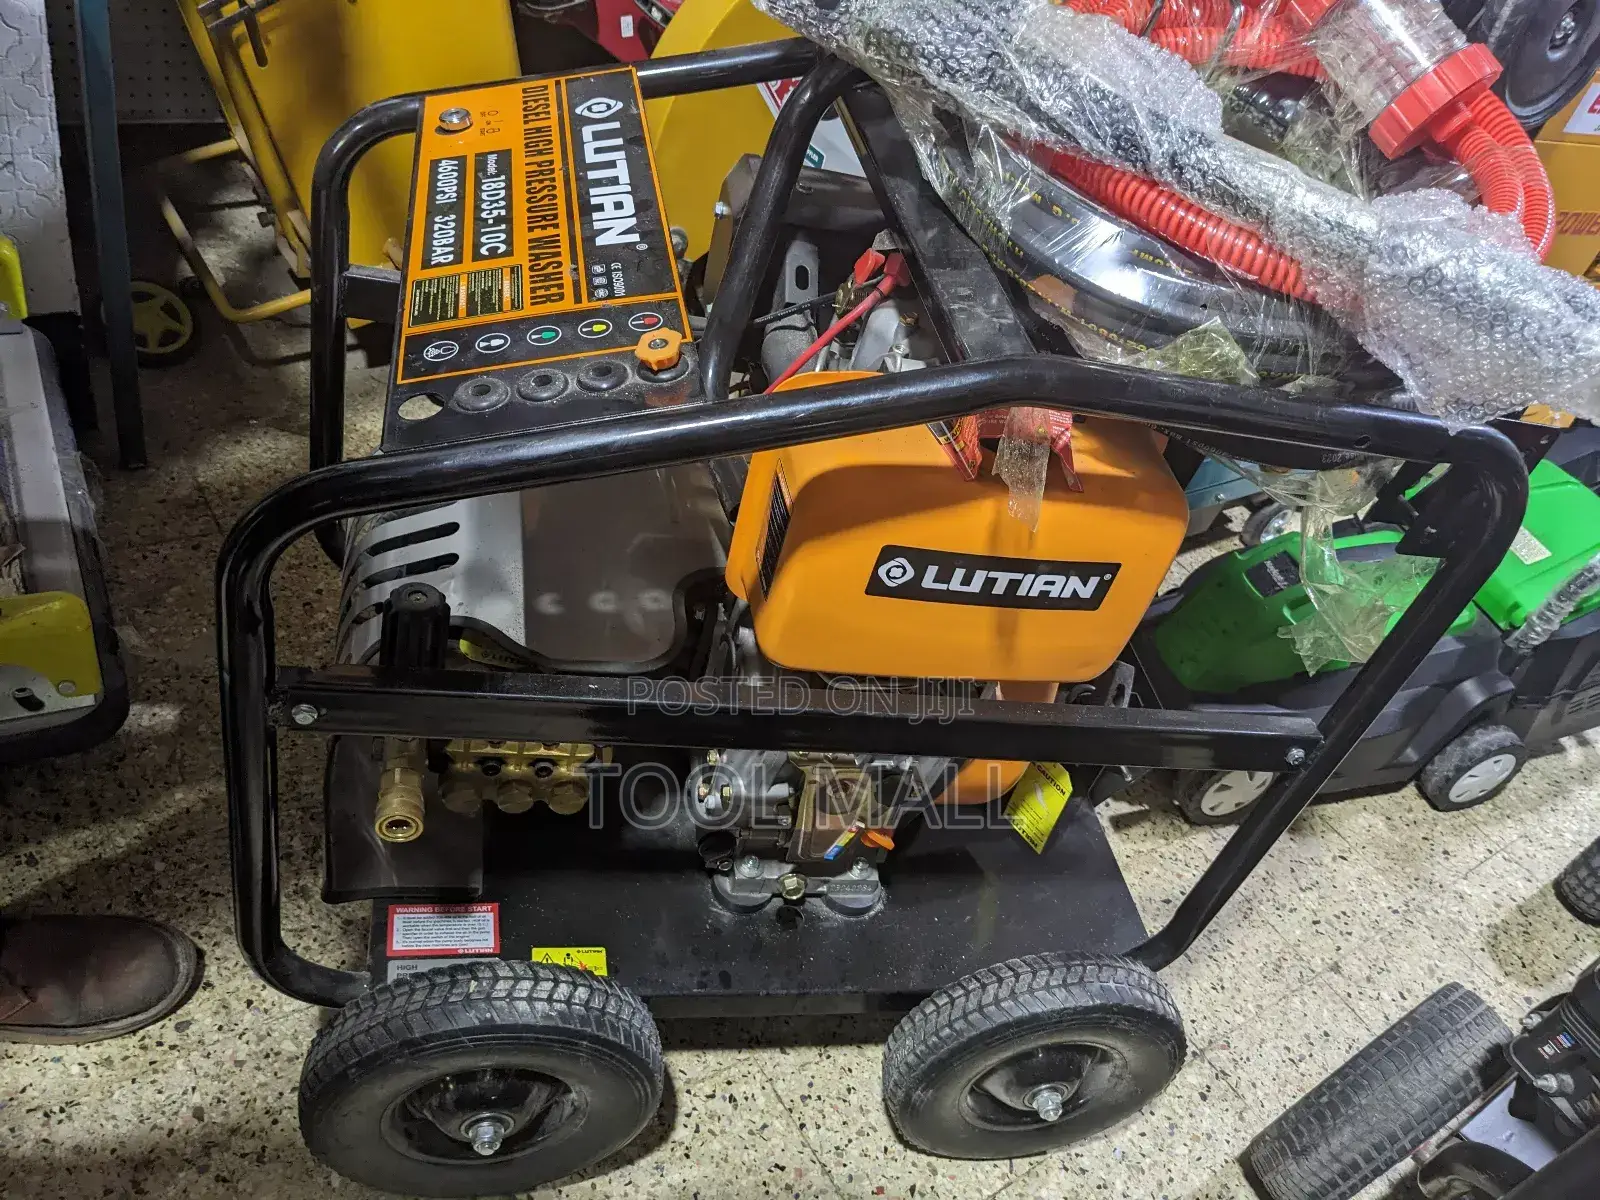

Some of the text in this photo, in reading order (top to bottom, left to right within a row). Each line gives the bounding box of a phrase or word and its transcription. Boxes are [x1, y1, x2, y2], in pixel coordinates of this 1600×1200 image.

[435, 158, 459, 205] 4600PSI
[486, 153, 499, 177] Model:
[582, 121, 640, 247] LUTIAN
[479, 175, 507, 257] 18D35-10C
[522, 85, 565, 306] DIESEL HIGH PRESSURE WASHER
[430, 214, 456, 266] 320BAR
[921, 564, 1101, 599] LUTIAN
[1036, 764, 1066, 796] CAUTION
